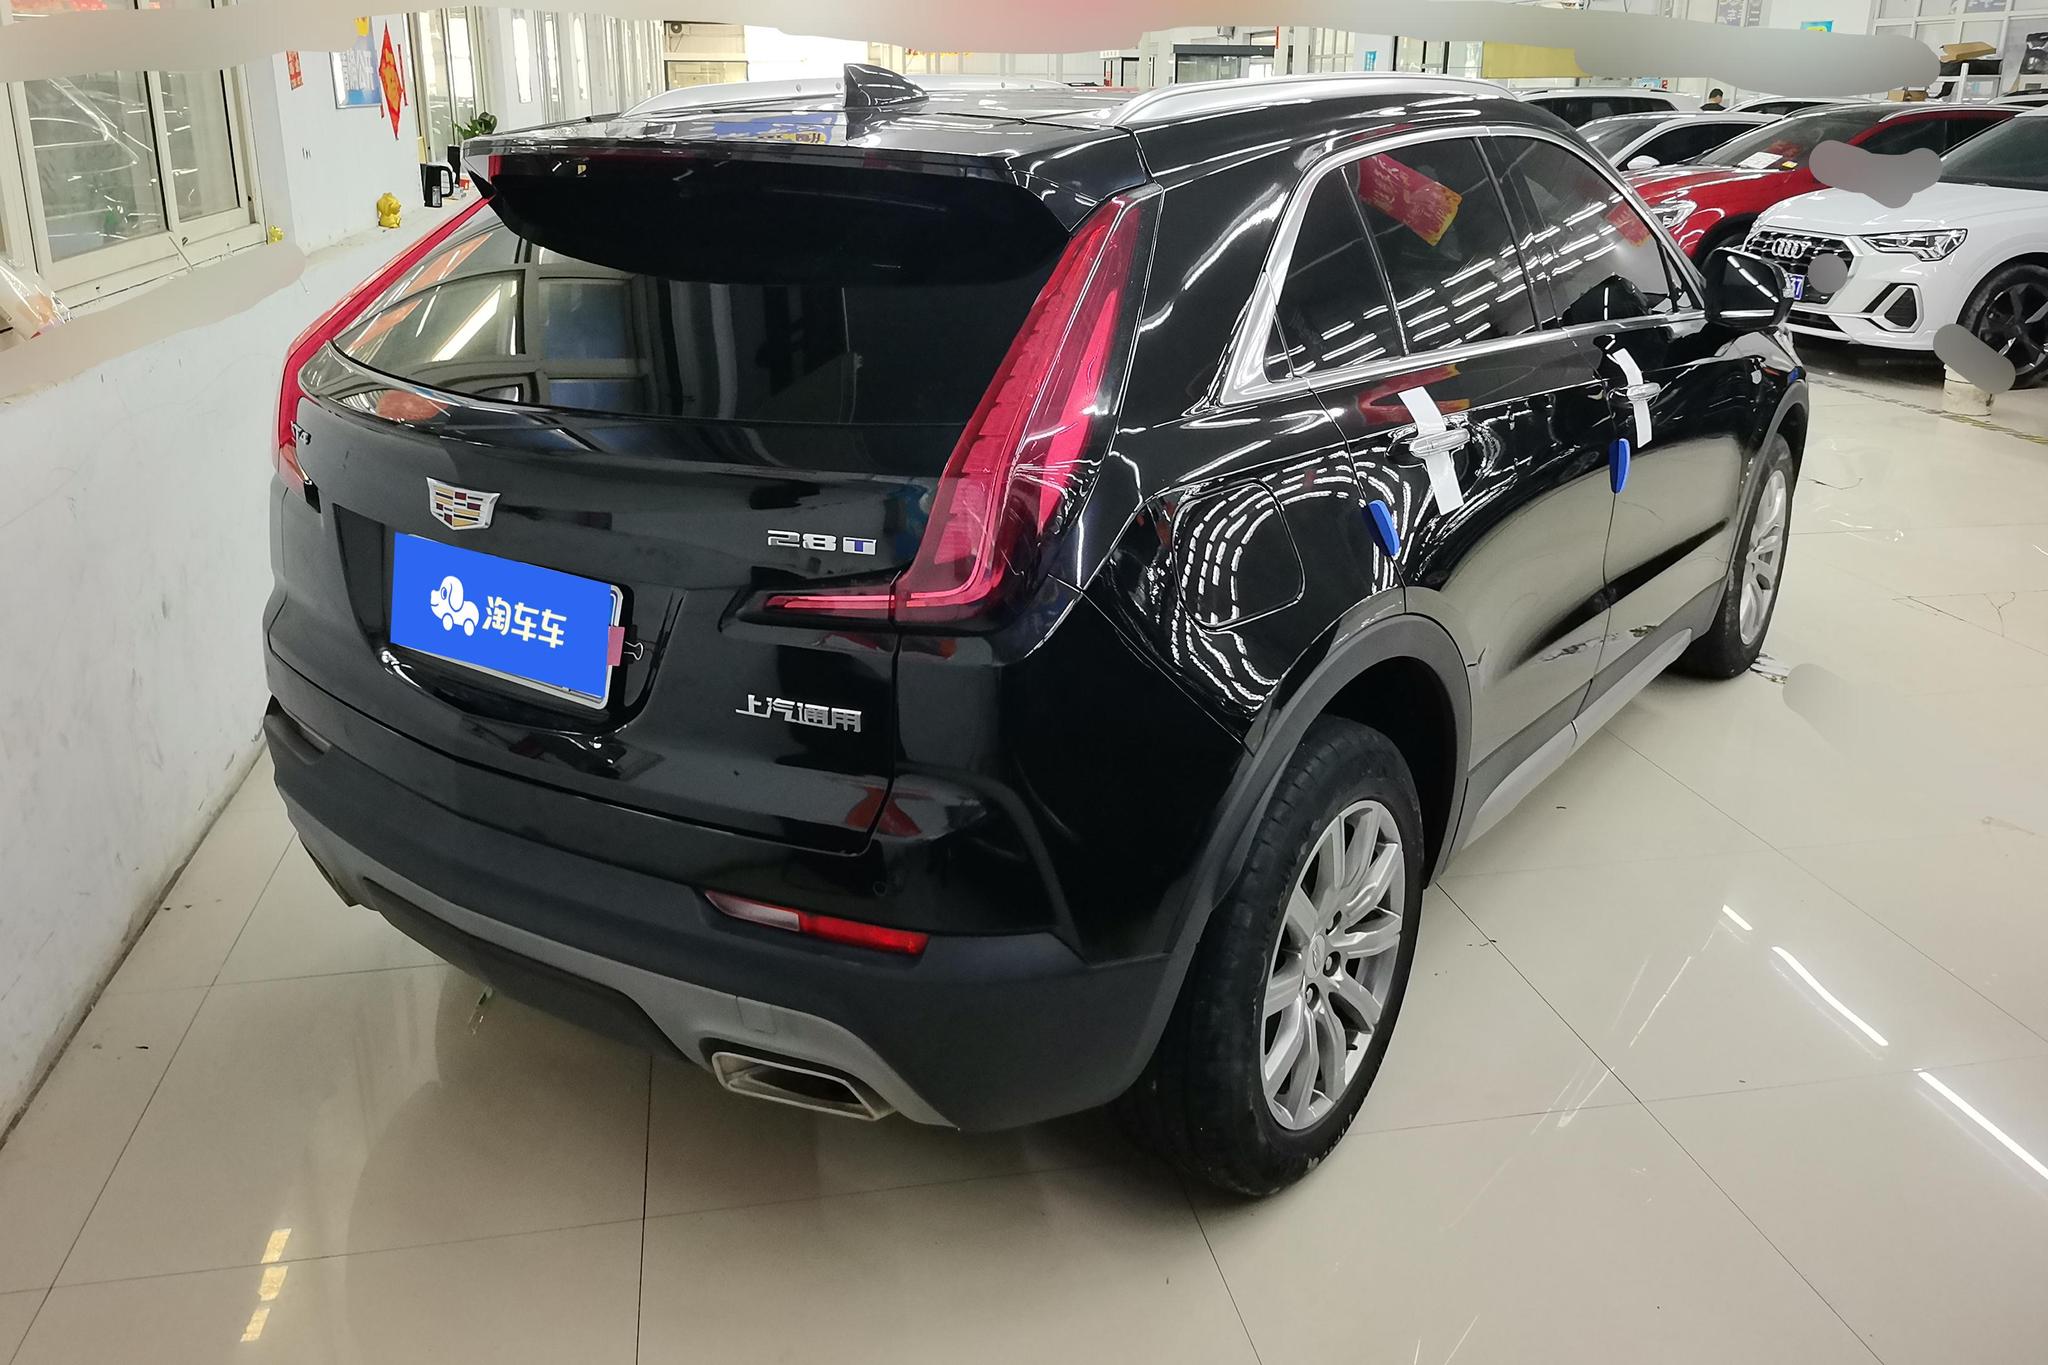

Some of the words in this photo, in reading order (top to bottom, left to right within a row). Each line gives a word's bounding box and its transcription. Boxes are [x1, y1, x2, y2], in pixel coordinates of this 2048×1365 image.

[767, 529, 877, 556] 28T
[735, 694, 862, 733] 上汽通用
